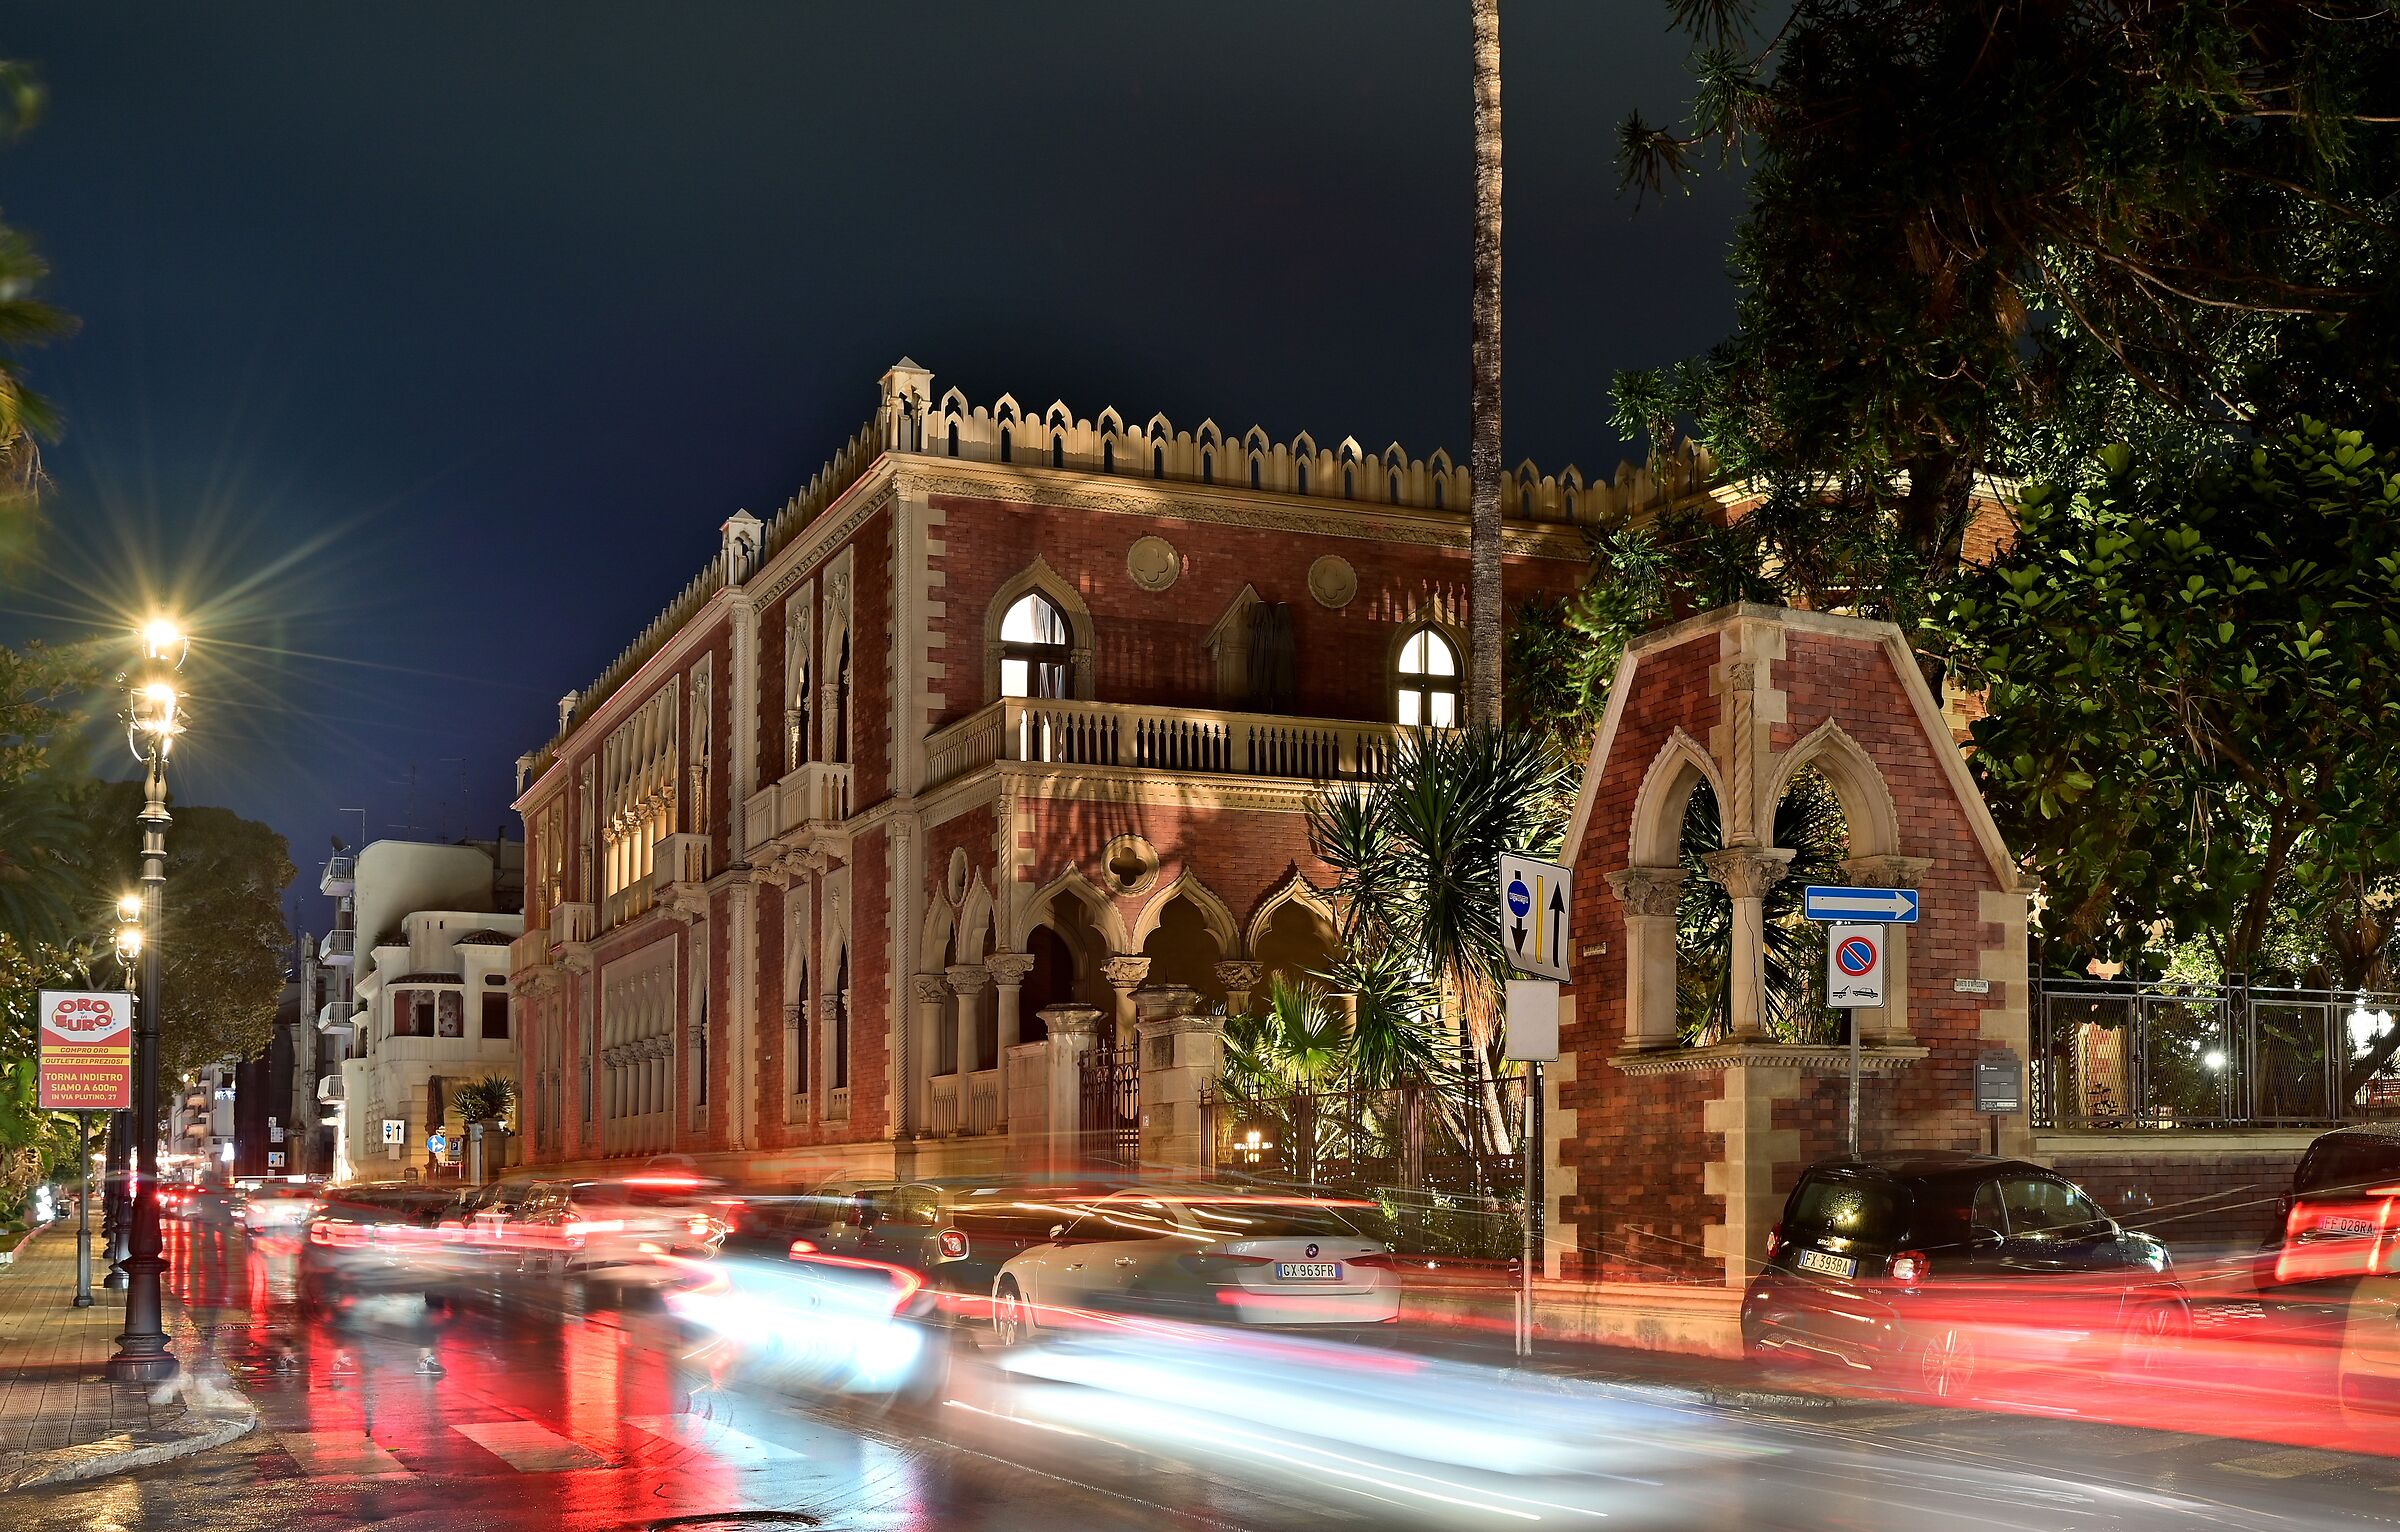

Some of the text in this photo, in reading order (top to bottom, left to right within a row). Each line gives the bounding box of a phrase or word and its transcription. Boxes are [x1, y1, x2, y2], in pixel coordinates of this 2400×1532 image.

[58, 999, 110, 1013] ORO
[55, 1015, 112, 1031] EURO
[45, 1073, 123, 1081] TORNA INDIETRO
[51, 1083, 81, 1091] SIAMO
[92, 1084, 118, 1092] 600m
[1283, 1264, 1334, 1277] GX 963FR
